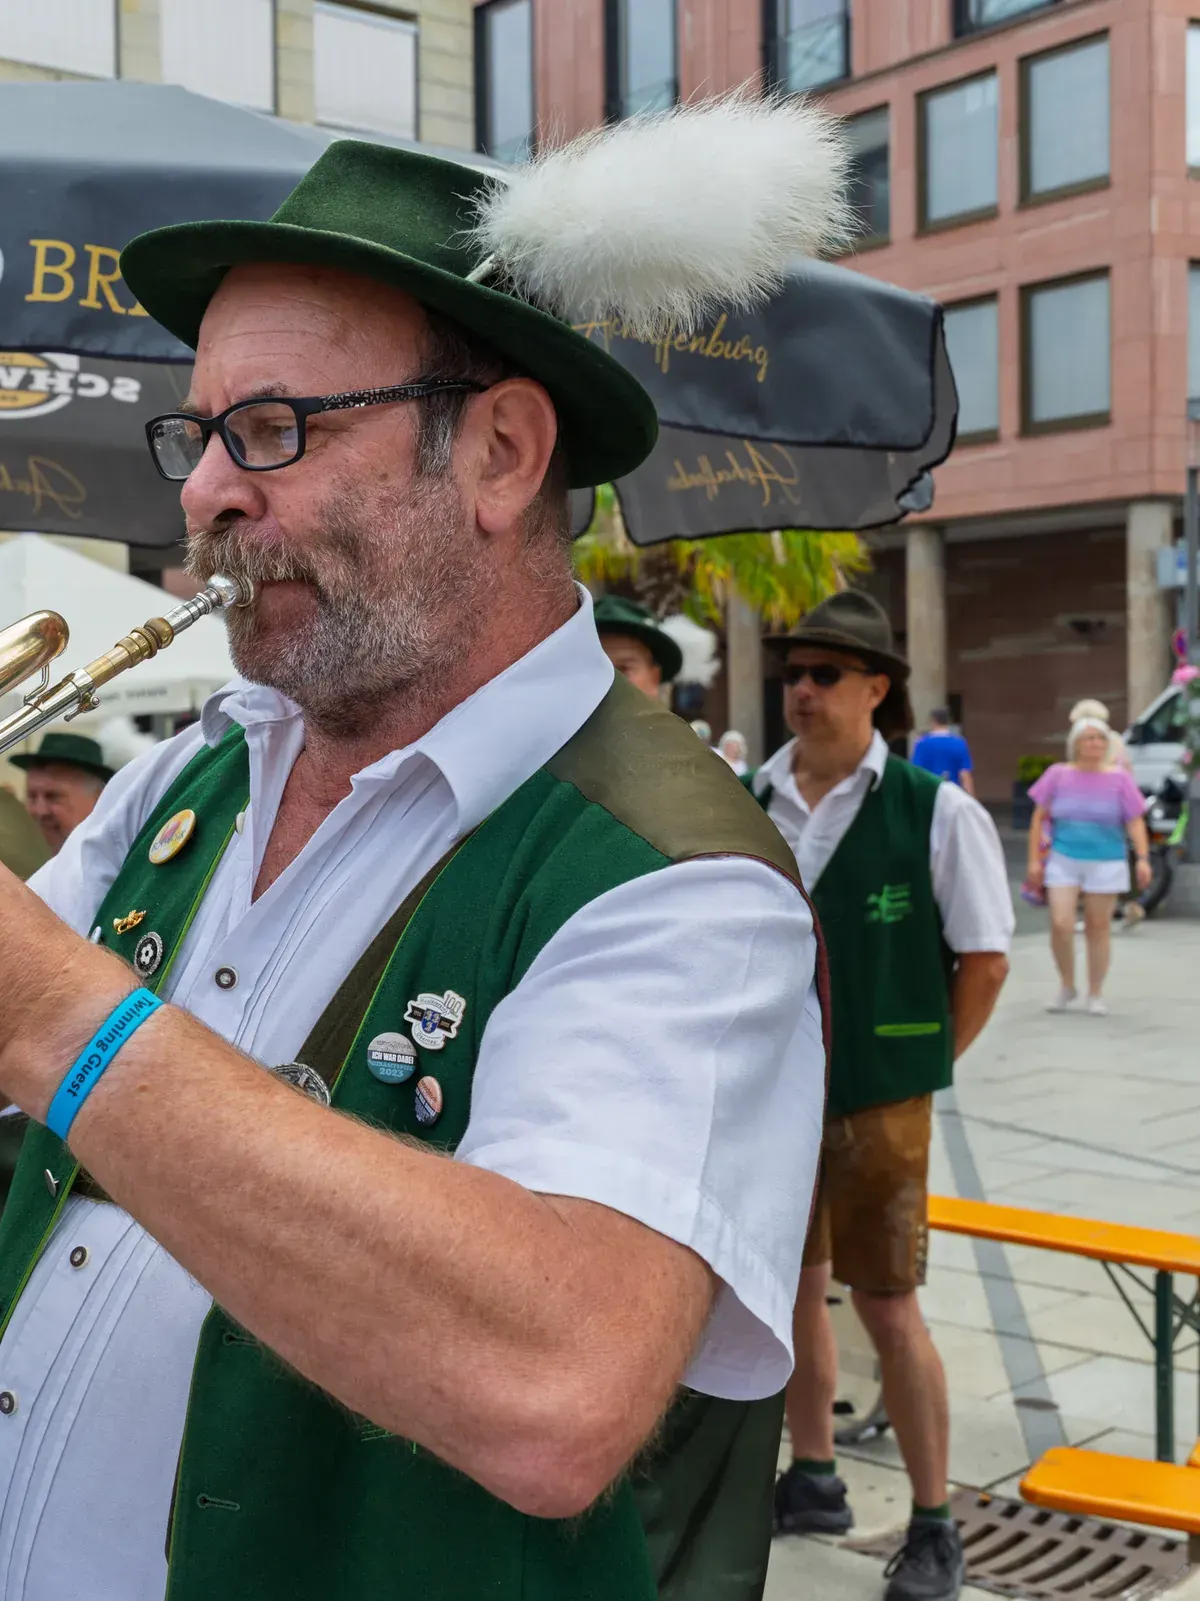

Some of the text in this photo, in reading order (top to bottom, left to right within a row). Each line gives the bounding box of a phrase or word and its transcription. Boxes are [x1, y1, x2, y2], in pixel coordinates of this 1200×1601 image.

[24, 238, 151, 317] BR
[443, 993, 462, 1014] 100
[67, 996, 154, 1097] Twinning Guest
[371, 1051, 414, 1065] ICH WAR DABEI
[379, 1067, 404, 1077] 2023
